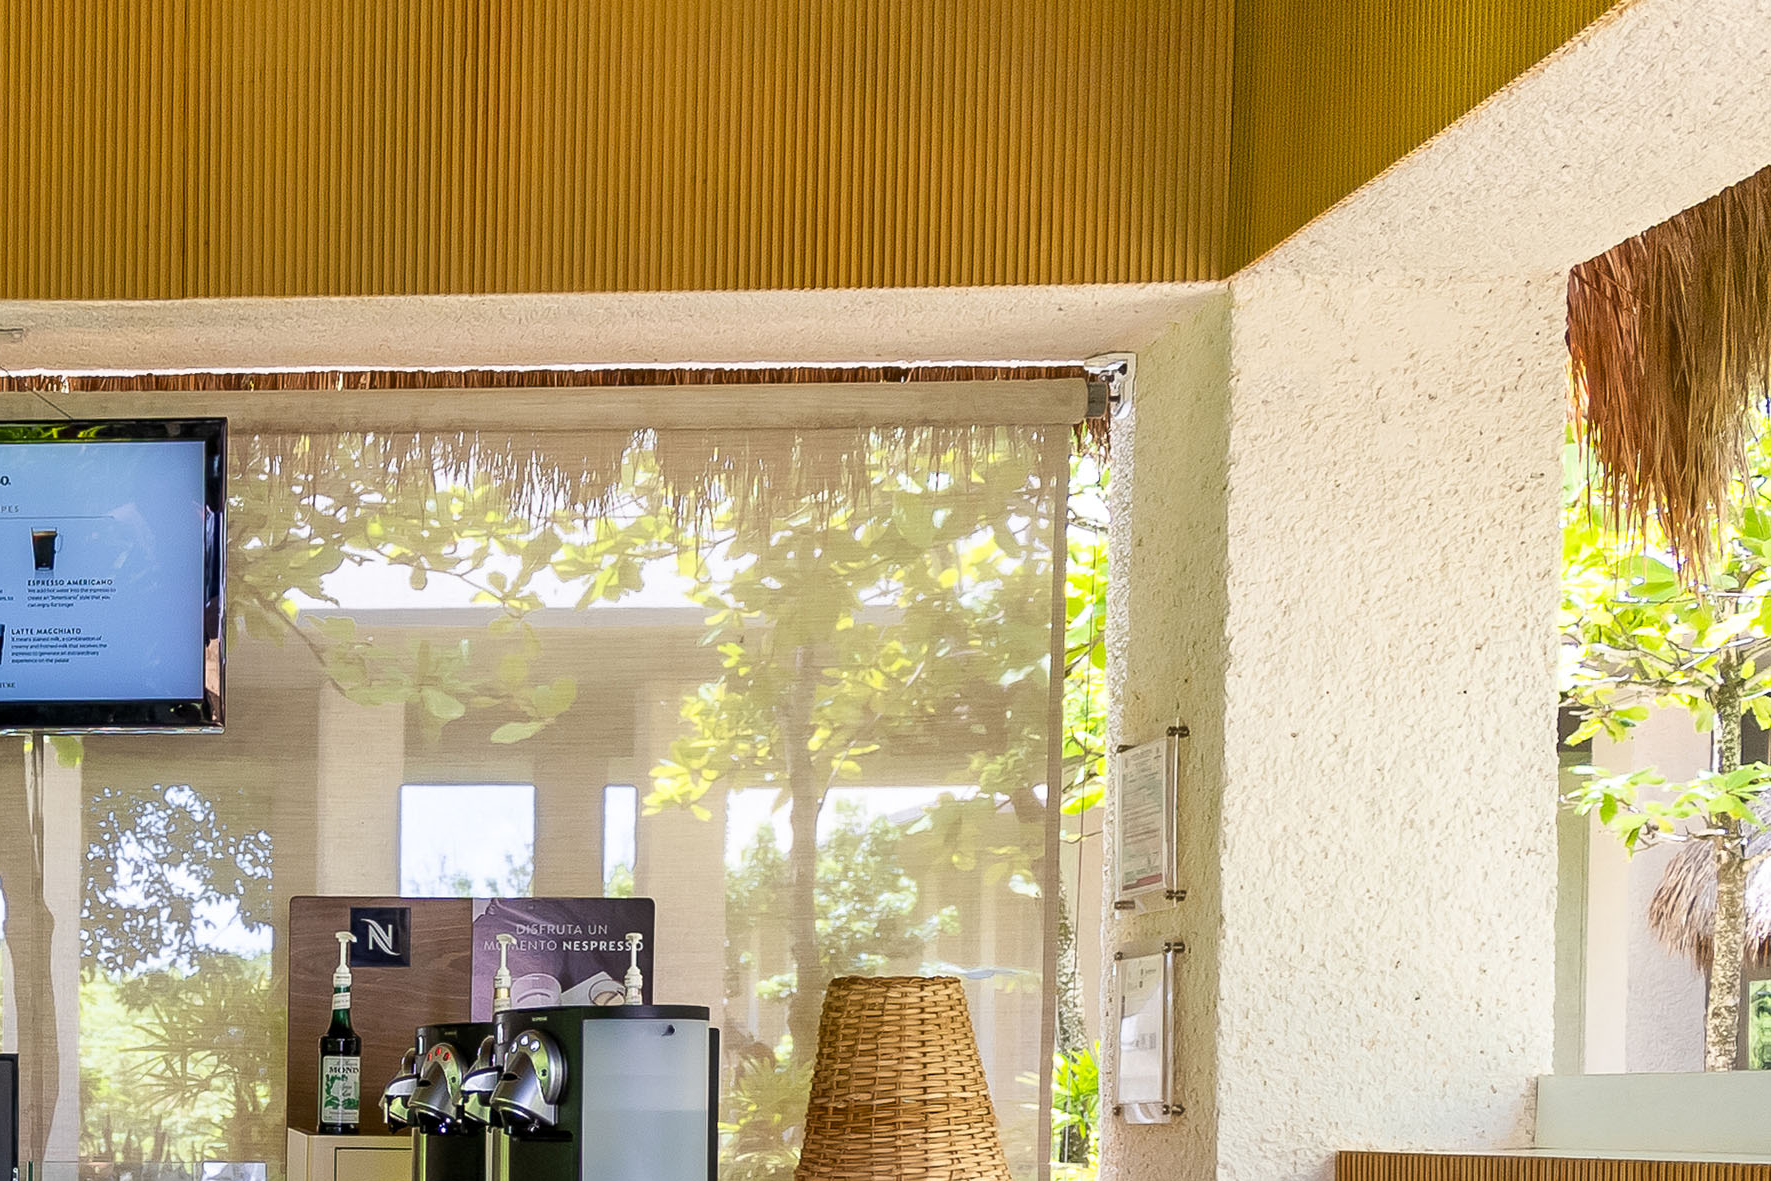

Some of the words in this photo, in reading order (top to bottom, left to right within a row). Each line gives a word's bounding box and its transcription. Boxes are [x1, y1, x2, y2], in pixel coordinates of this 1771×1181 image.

[360, 918, 401, 956] N
[516, 924, 583, 935] DISFRUTA
[588, 924, 608, 935] UN
